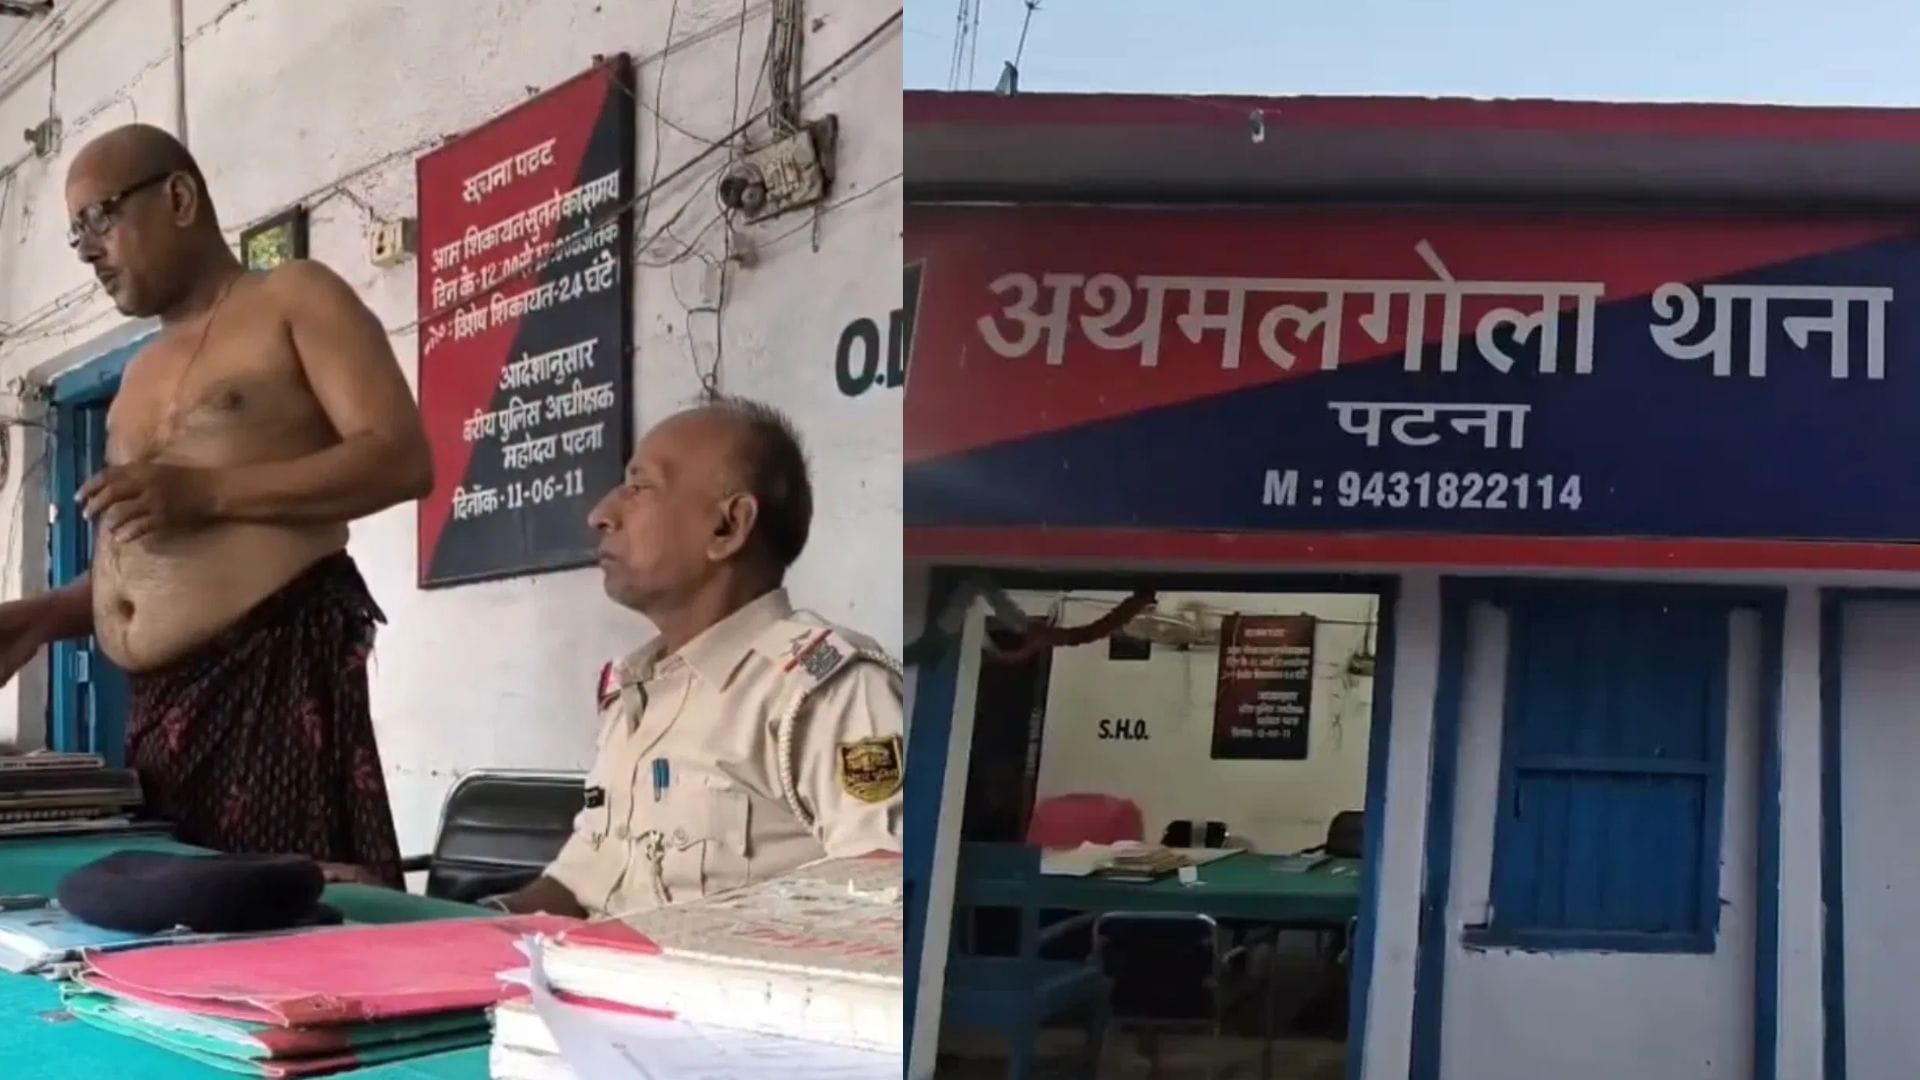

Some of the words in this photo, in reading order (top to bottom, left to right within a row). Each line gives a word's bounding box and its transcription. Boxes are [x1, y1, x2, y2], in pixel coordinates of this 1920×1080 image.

[462, 157, 514, 204] सूचना
[431, 239, 462, 273] आम
[463, 211, 526, 259] शिकायत
[525, 187, 562, 242] सुनने
[562, 185, 583, 218] का
[582, 168, 620, 215] समय
[432, 277, 459, 310] दिन
[976, 238, 1605, 374] अथमलगोला
[1649, 282, 1893, 379] थाना
[499, 337, 599, 390] आदेशानुसार
[498, 396, 542, 443] पुलिस
[1328, 401, 1531, 449] पटना
[501, 433, 558, 469] महोदय
[561, 422, 604, 456] पटना
[1262, 469, 1299, 506] M
[1337, 470, 1582, 510] 9431822114
[1098, 718, 1149, 740] S.H.O.
